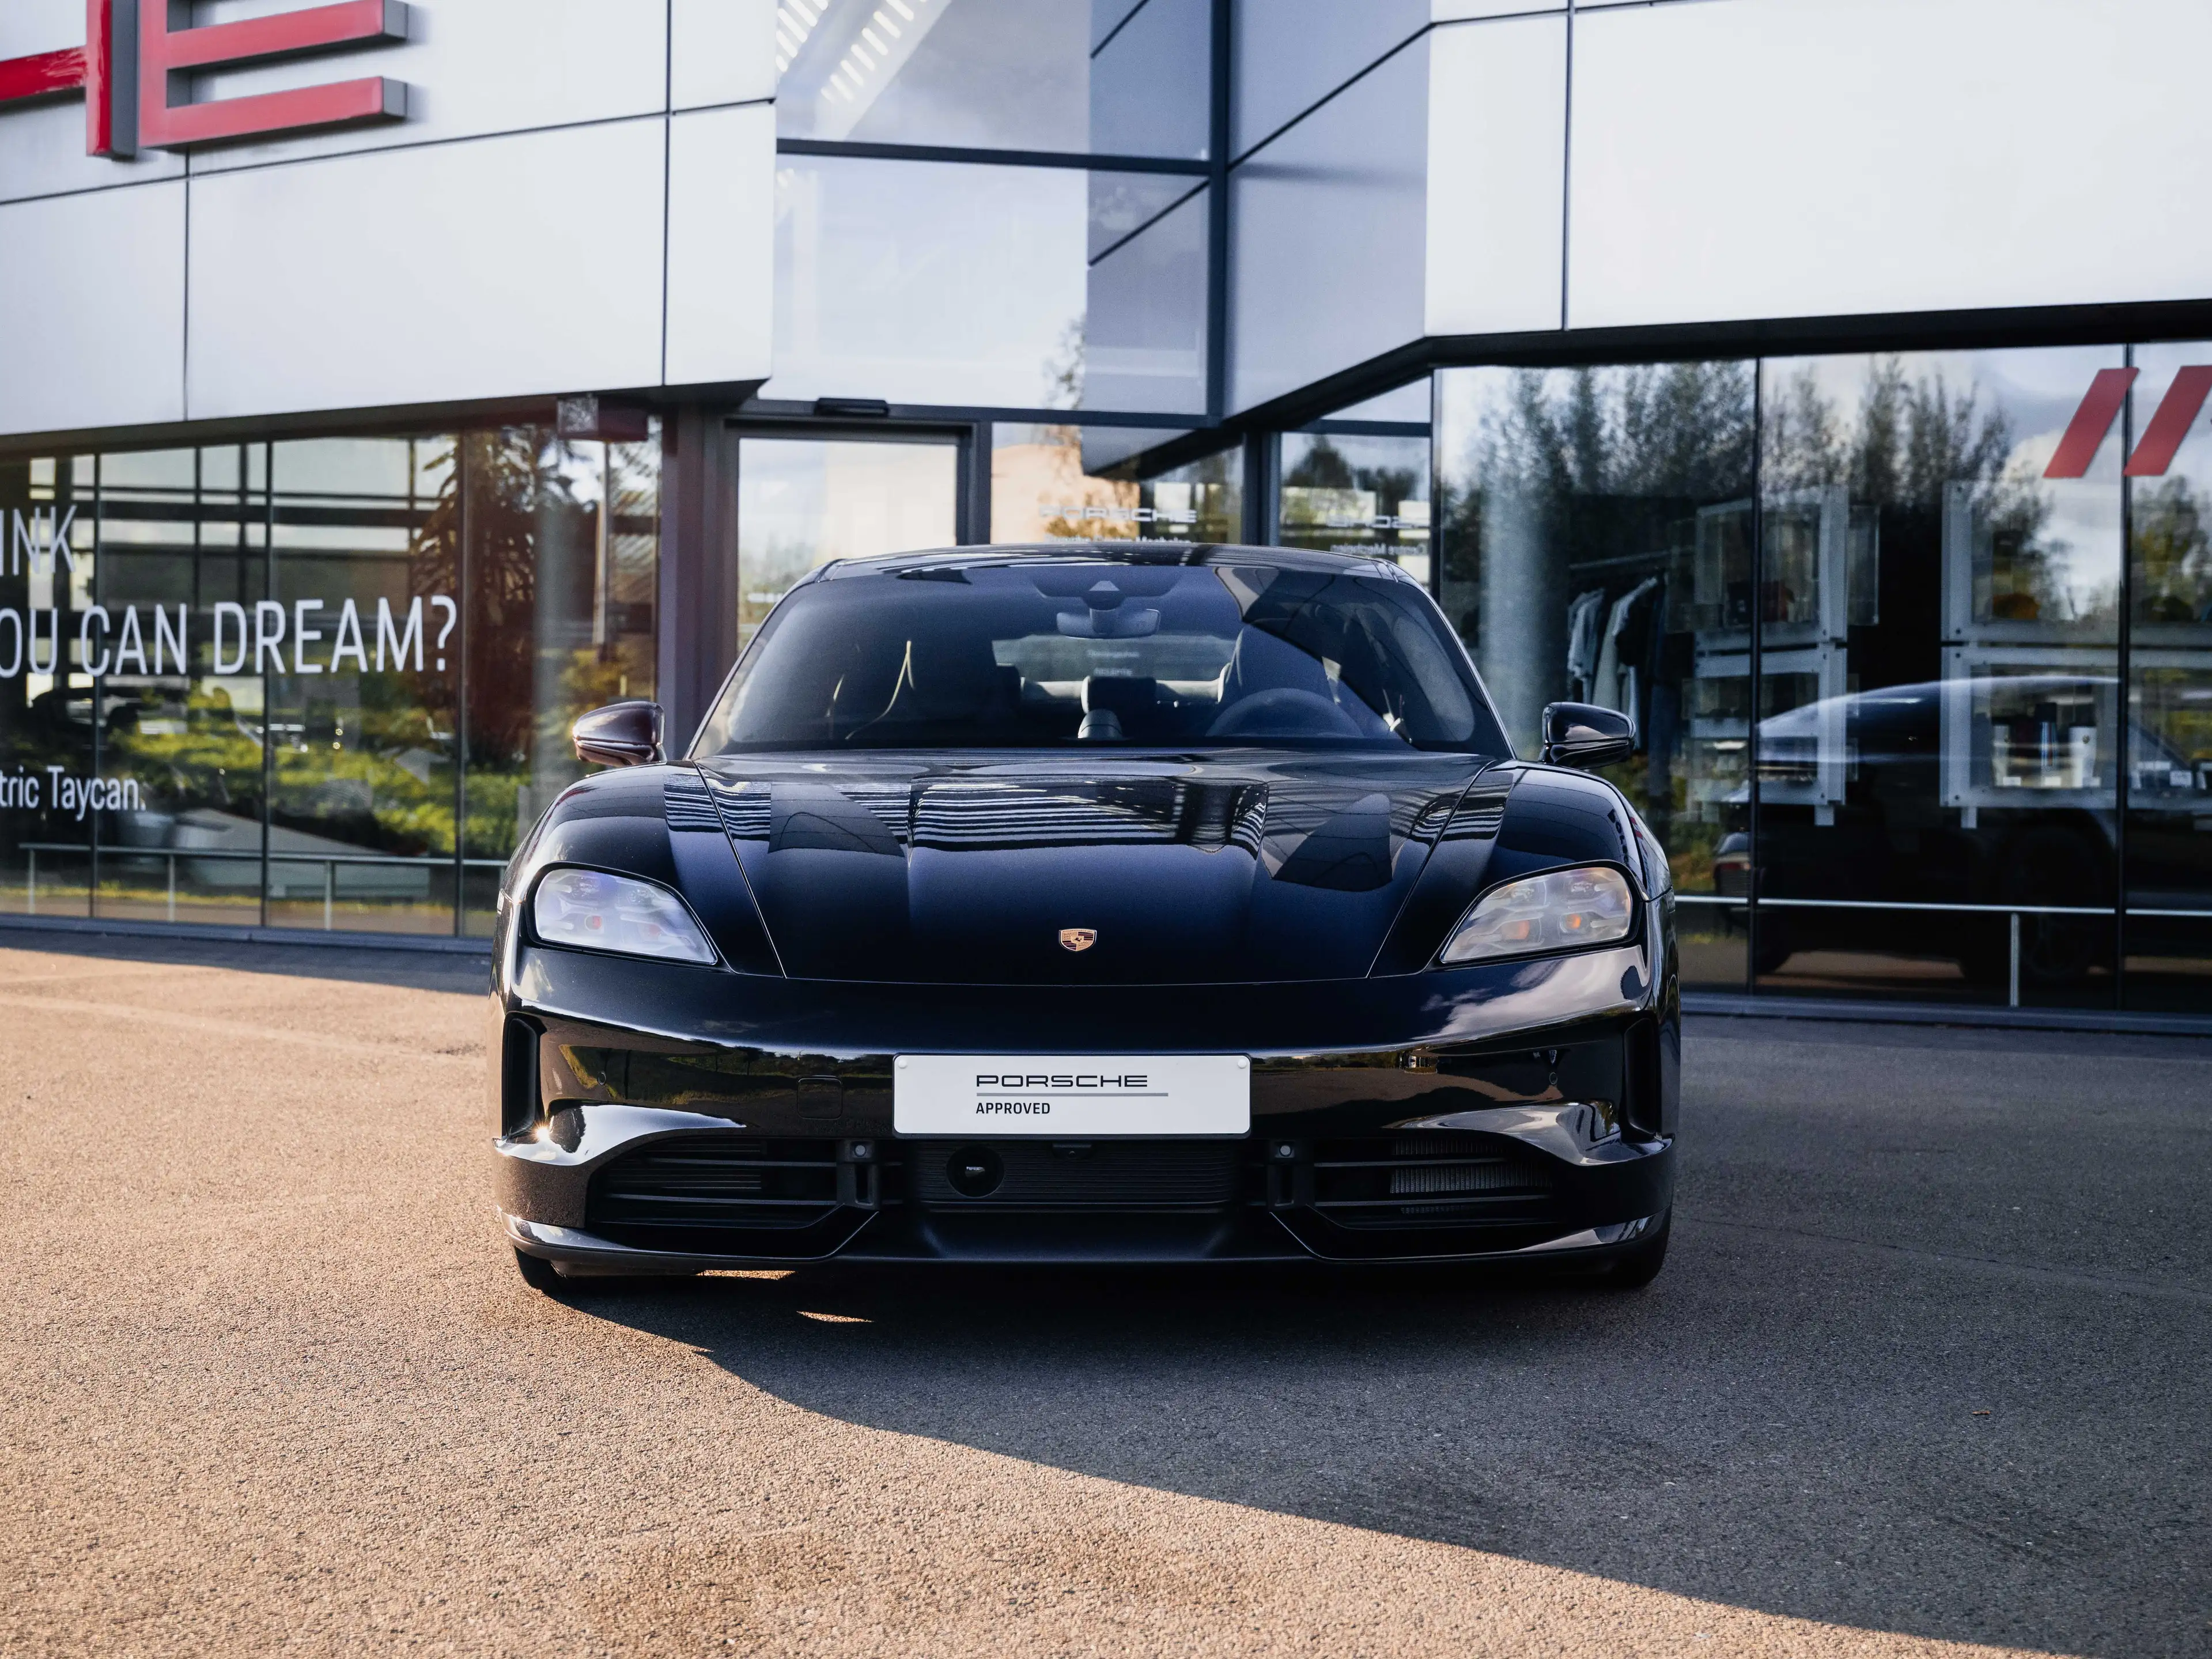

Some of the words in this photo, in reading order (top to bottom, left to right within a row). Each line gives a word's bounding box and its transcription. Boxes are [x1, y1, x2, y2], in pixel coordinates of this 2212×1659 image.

[80, 603, 187, 677] CAN
[214, 595, 457, 674] DREAM?
[46, 765, 146, 821] Taycan.
[976, 1075, 1148, 1088] PORSCHE
[975, 1102, 1051, 1115] APPROVED
